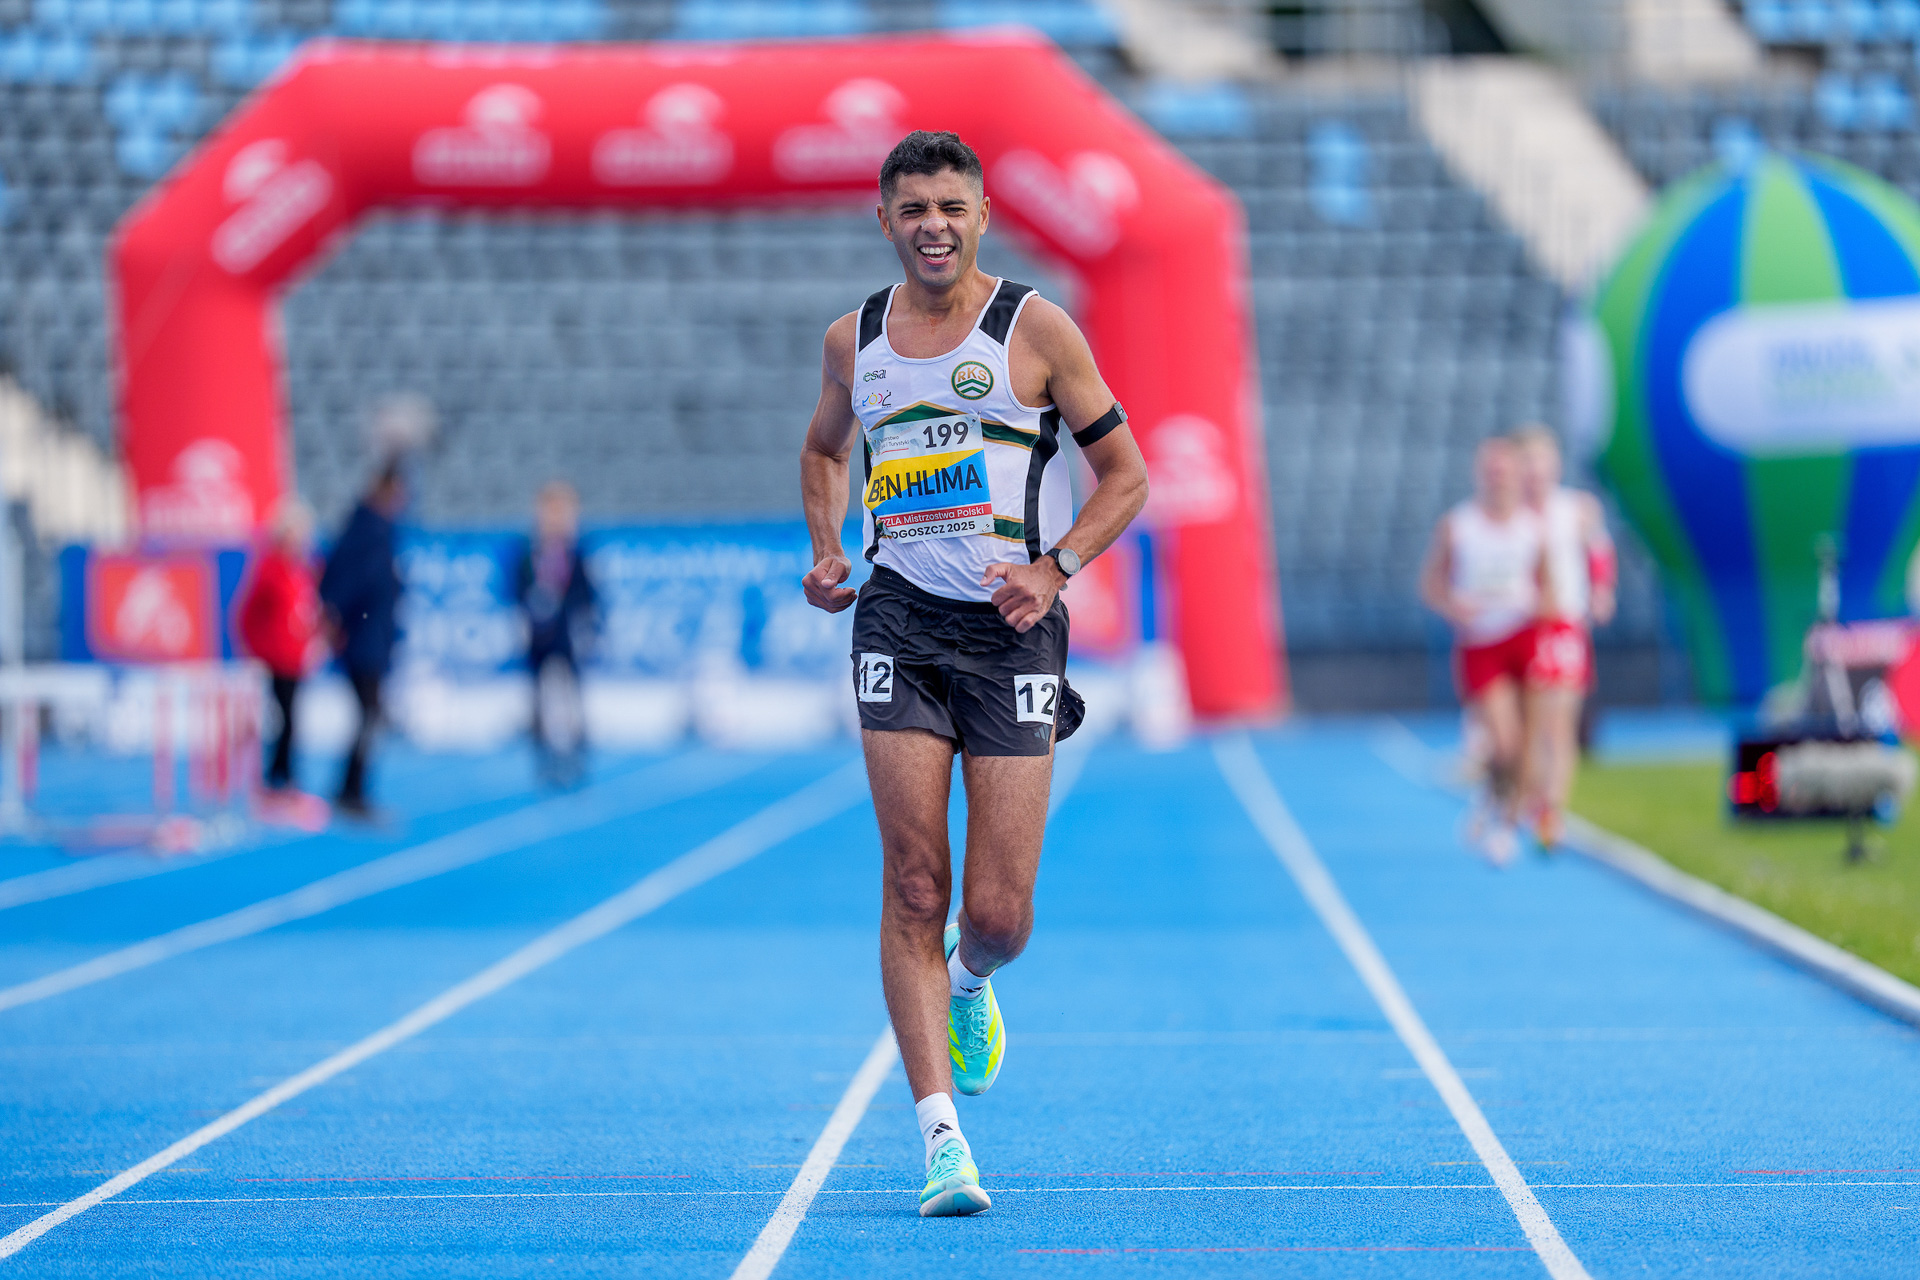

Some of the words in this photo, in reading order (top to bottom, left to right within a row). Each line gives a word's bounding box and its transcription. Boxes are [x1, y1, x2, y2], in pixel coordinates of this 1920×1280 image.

[957, 366, 987, 382] RKS
[922, 421, 969, 449] 199
[867, 473, 903, 503] BEN
[905, 463, 983, 498] HLIMA
[904, 511, 955, 525] Mistrzostwa
[957, 505, 985, 517] Polski
[891, 525, 945, 540] DGOSZCZ
[947, 520, 976, 532] 2025
[861, 660, 892, 694] 12
[1018, 681, 1057, 716] 12
